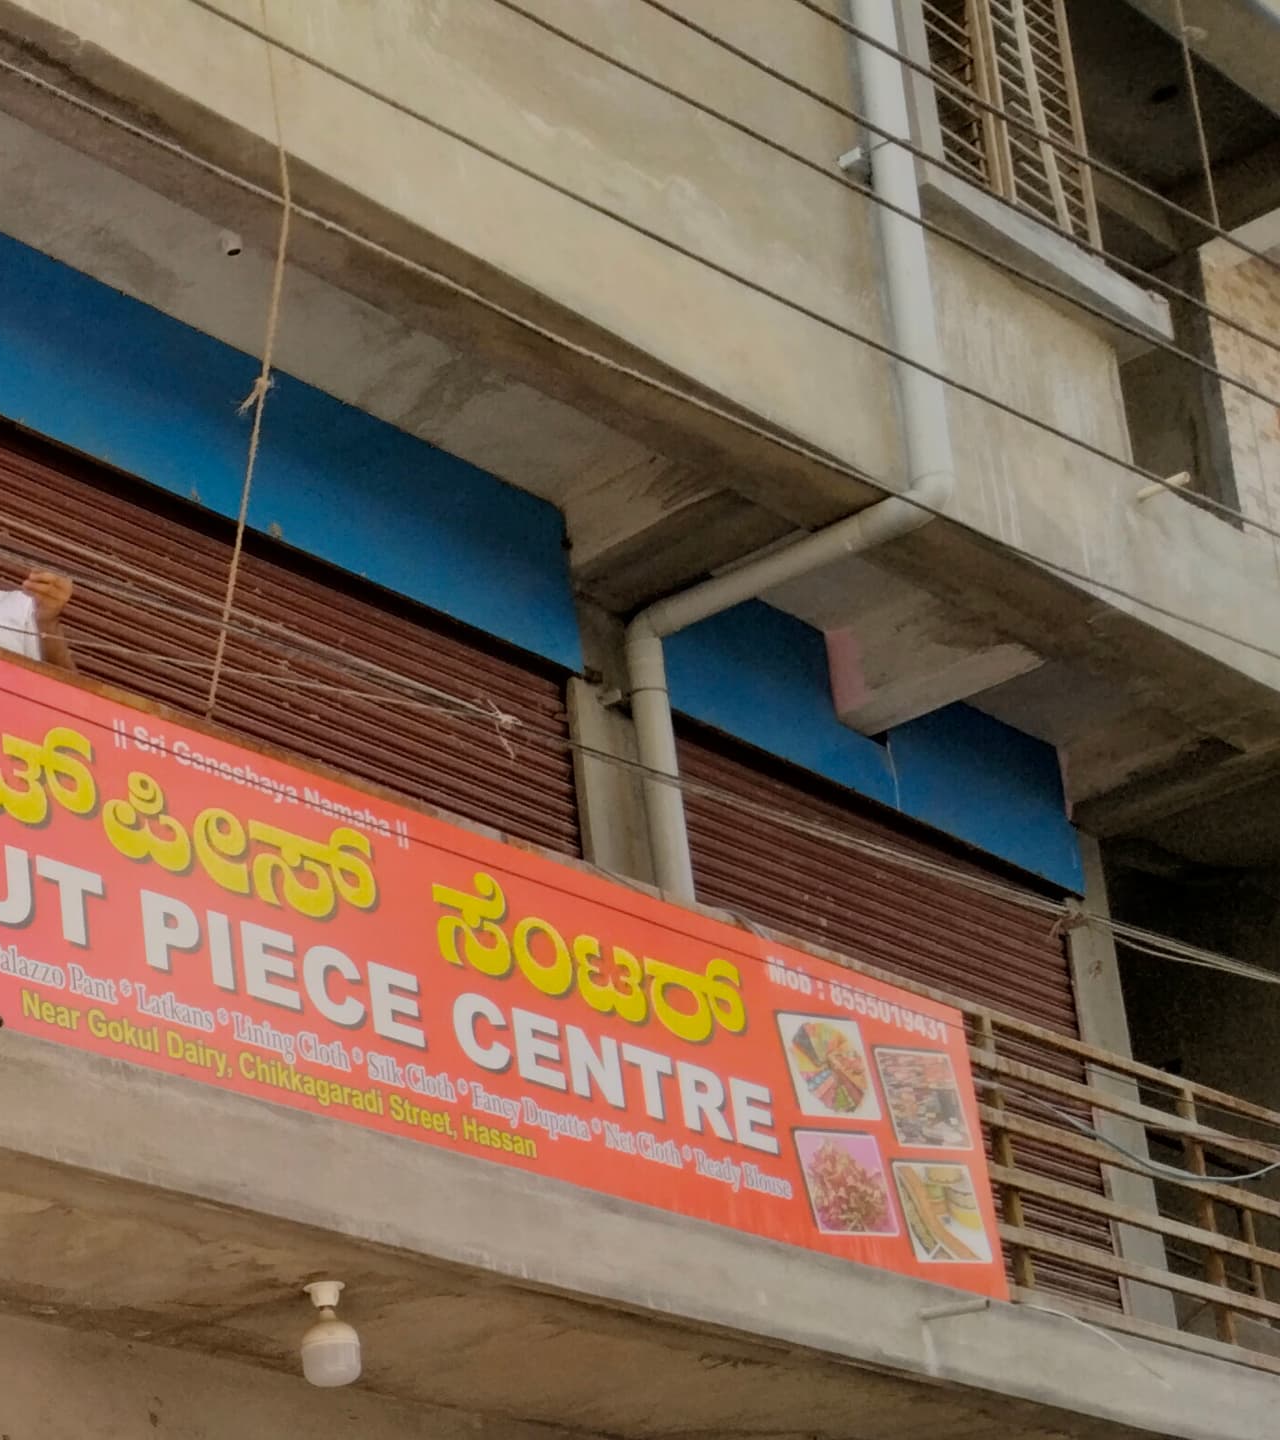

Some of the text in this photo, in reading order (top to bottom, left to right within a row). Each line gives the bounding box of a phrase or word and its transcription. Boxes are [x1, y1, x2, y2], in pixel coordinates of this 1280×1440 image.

[133, 726, 167, 759] Sri
[172, 740, 299, 805] Ganeshaya
[304, 786, 391, 839] Namaha
[140, 889, 426, 1048] PIECE
[451, 992, 780, 1155] CENTRE
[431, 871, 747, 1044] ಸೆಂಟರ್
[21, 989, 538, 1159] Near Gokul Dairy, Chikkagaradi Street, Hassan
[68, 962, 118, 1003] Pant
[136, 984, 215, 1033] Latkans
[231, 1010, 297, 1064] Lining
[298, 1032, 352, 1071] Cloth
[367, 1052, 404, 1088] Silk
[405, 1063, 457, 1103] Cloth
[469, 1081, 521, 1129] Fancy
[522, 1096, 592, 1141] Dupatta
[692, 1148, 743, 1193] Ready
[742, 1161, 793, 1200] Blouse
